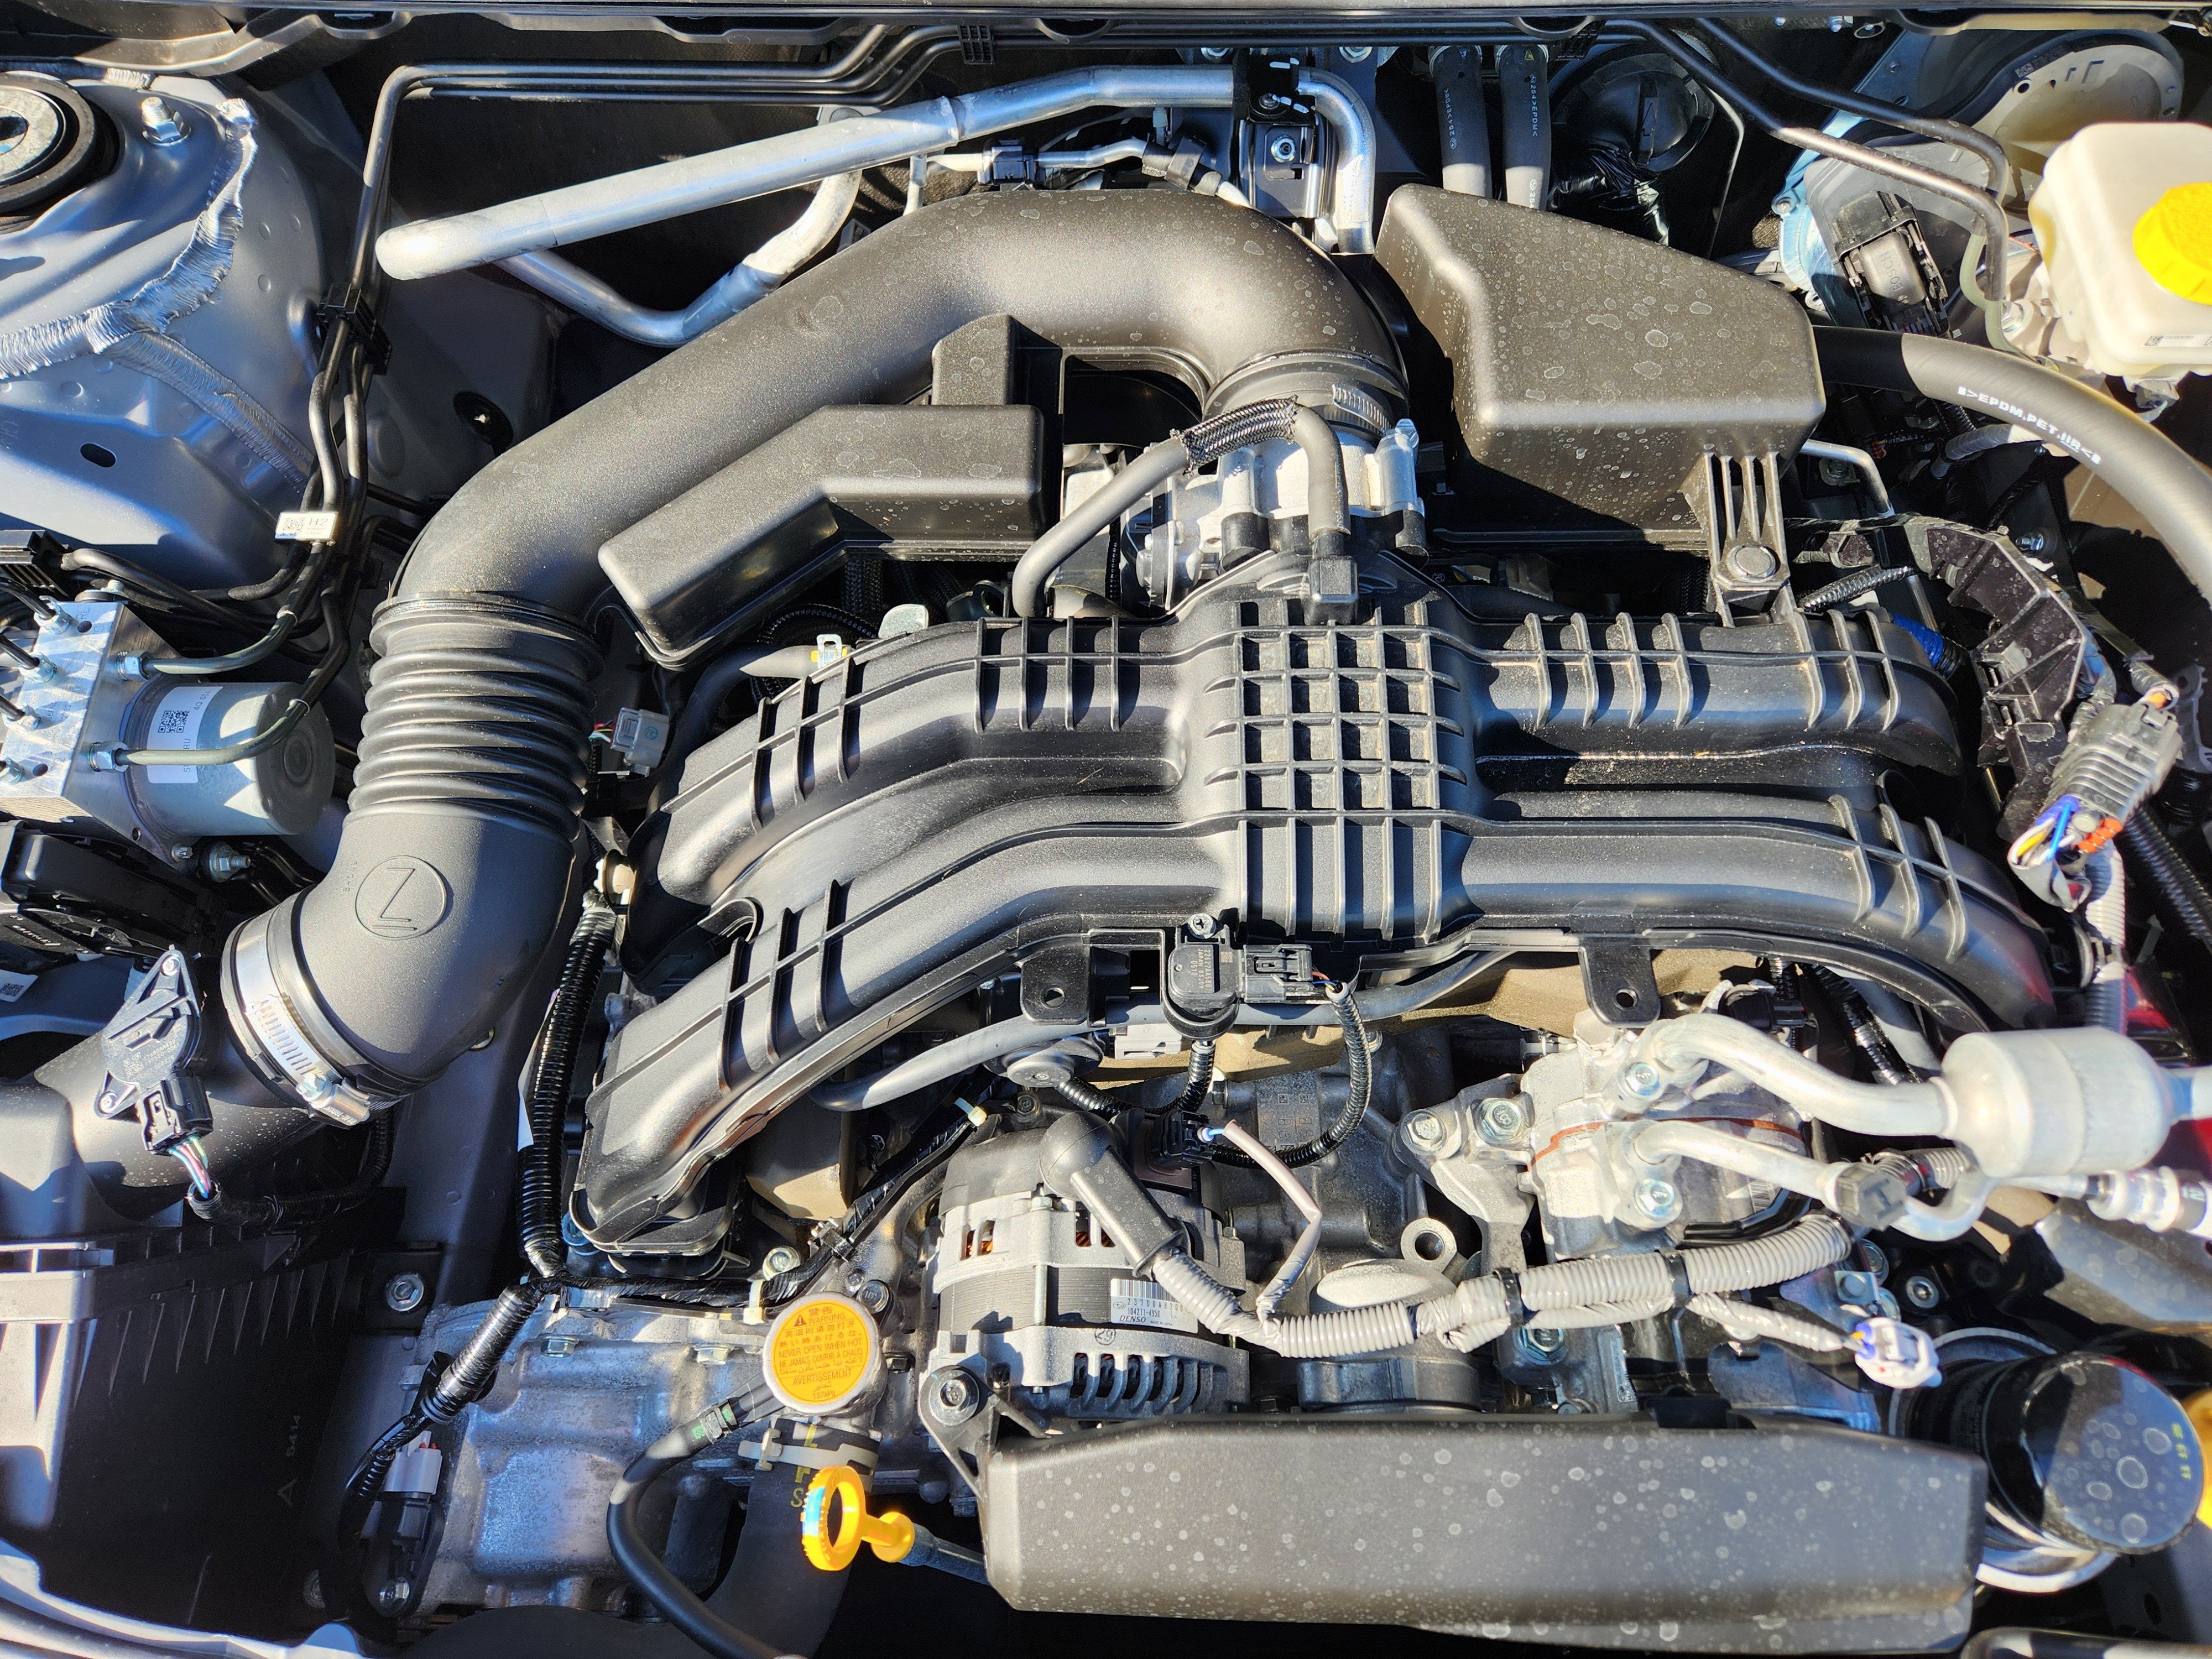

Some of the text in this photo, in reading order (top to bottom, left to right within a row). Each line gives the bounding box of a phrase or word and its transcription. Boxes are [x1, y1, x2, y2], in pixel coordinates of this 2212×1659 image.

[1881, 252, 1903, 292] BOSCH
[1127, 1296, 1191, 1314] 23700AB200
[1128, 1307, 1160, 1318] 104211-4950
[808, 1313, 846, 1324] WARNING
[779, 1348, 801, 1358] NEVER
[804, 1344, 822, 1354] OPEN
[825, 1341, 846, 1351] WHEN
[789, 1357, 810, 1367] JAMAIS
[812, 1353, 834, 1363] OUVRIR
[792, 1369, 853, 1386] AVERTISSEMENT
[813, 1391, 836, 1400] 137kPa
